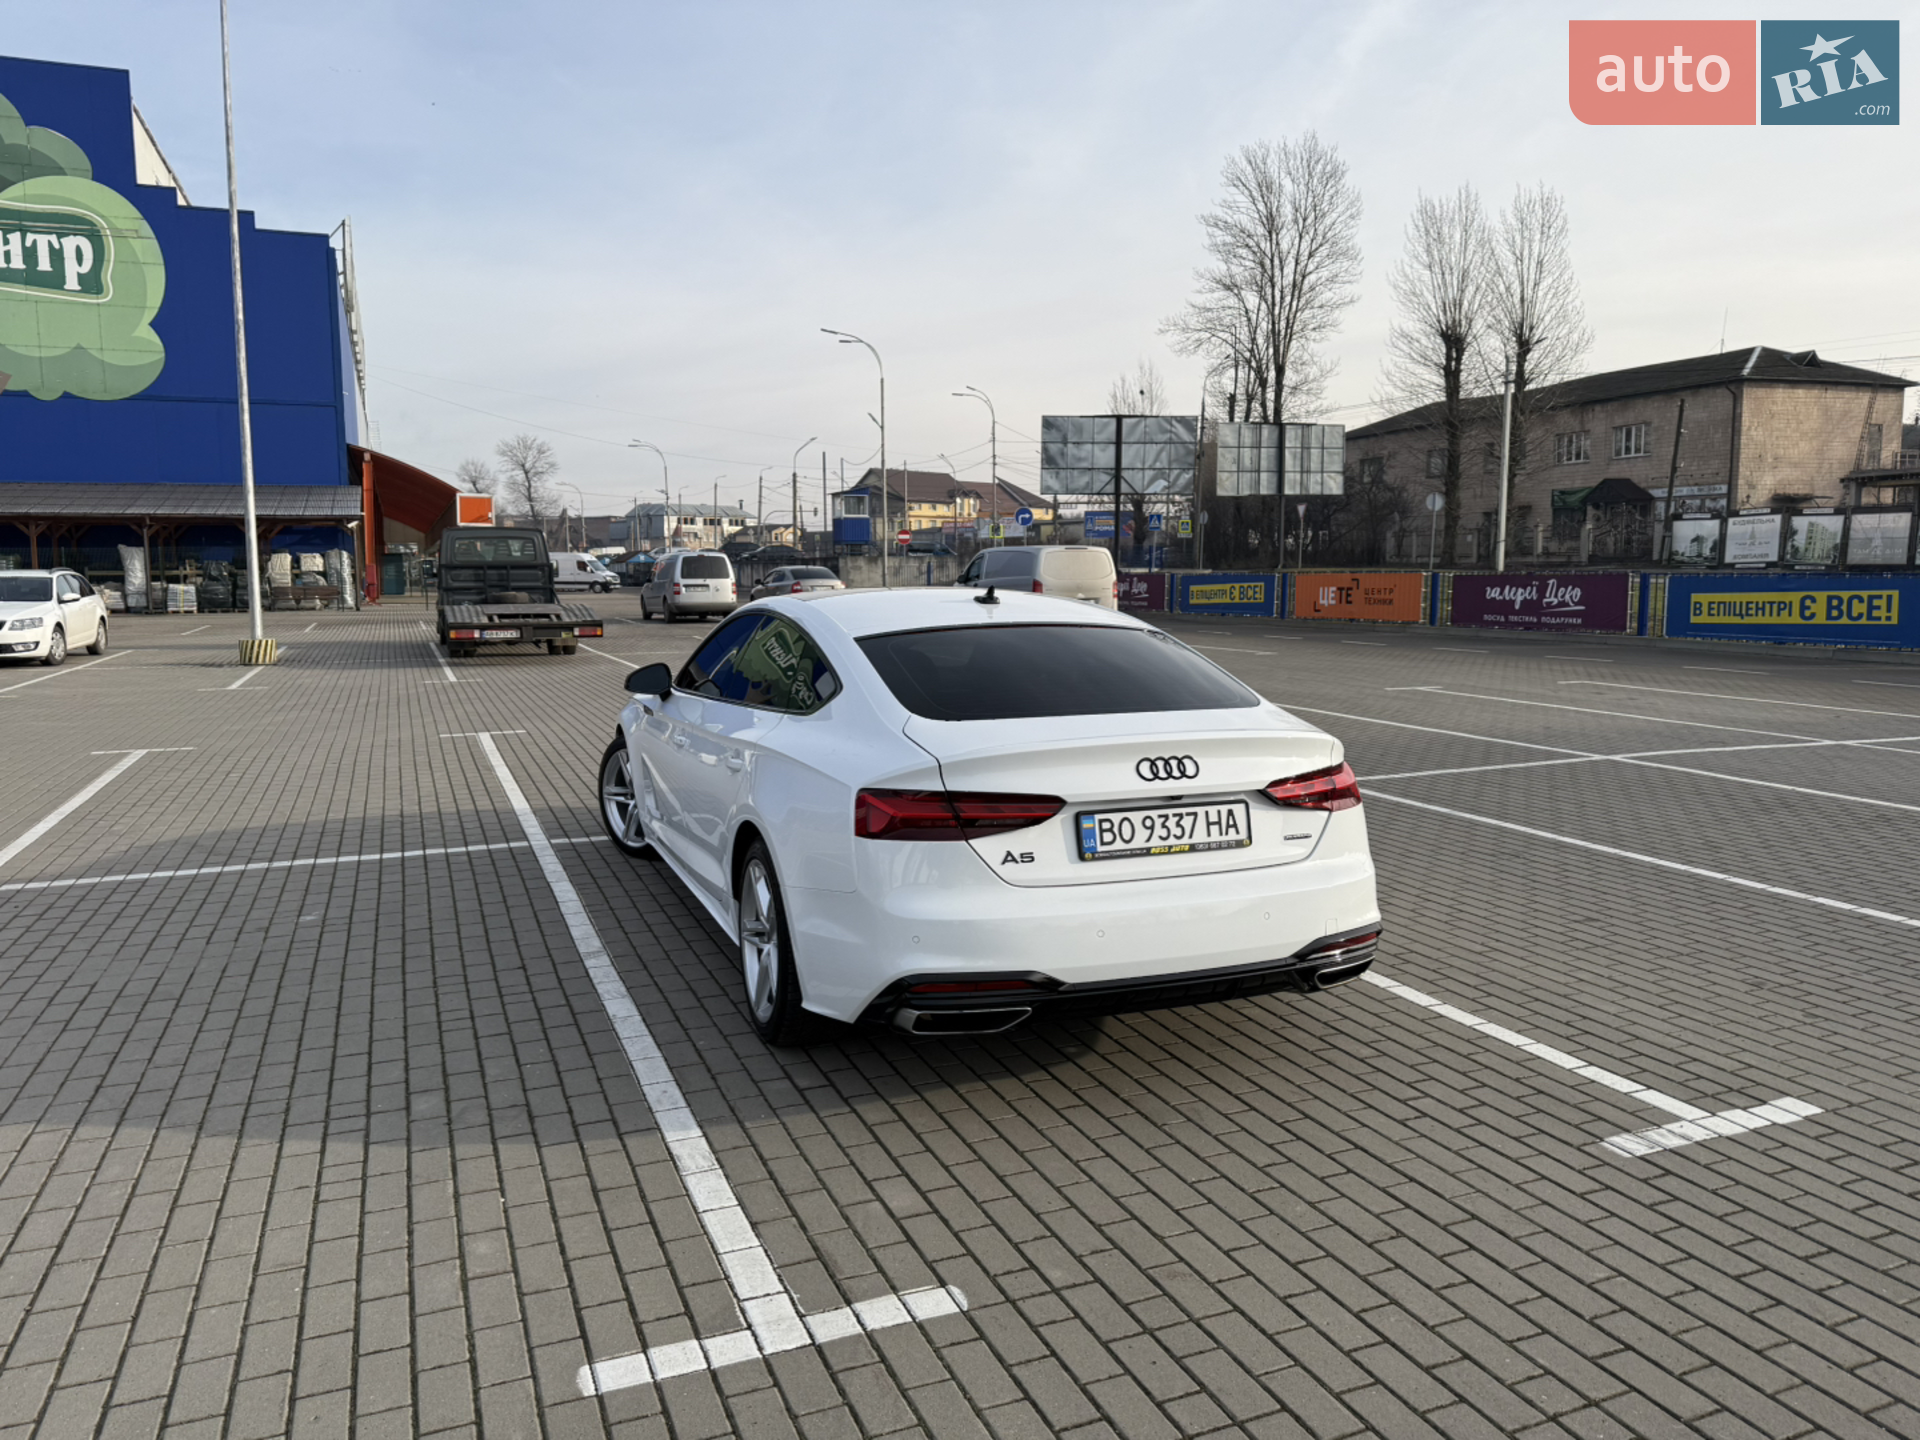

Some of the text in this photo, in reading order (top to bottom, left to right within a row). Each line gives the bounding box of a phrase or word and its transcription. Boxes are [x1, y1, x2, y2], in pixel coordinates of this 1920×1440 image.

[1229, 585, 1236, 601] Є
[1239, 584, 1263, 601] ВСЕ!
[1319, 586, 1354, 606] ЦЕТЕ
[1692, 594, 1894, 622] В ЕПІЦЕНТРІ Є ВСЕ!
[1099, 808, 1241, 846] BO 9337 HA
[1083, 838, 1096, 848] UA
[1000, 850, 1036, 866] A5
